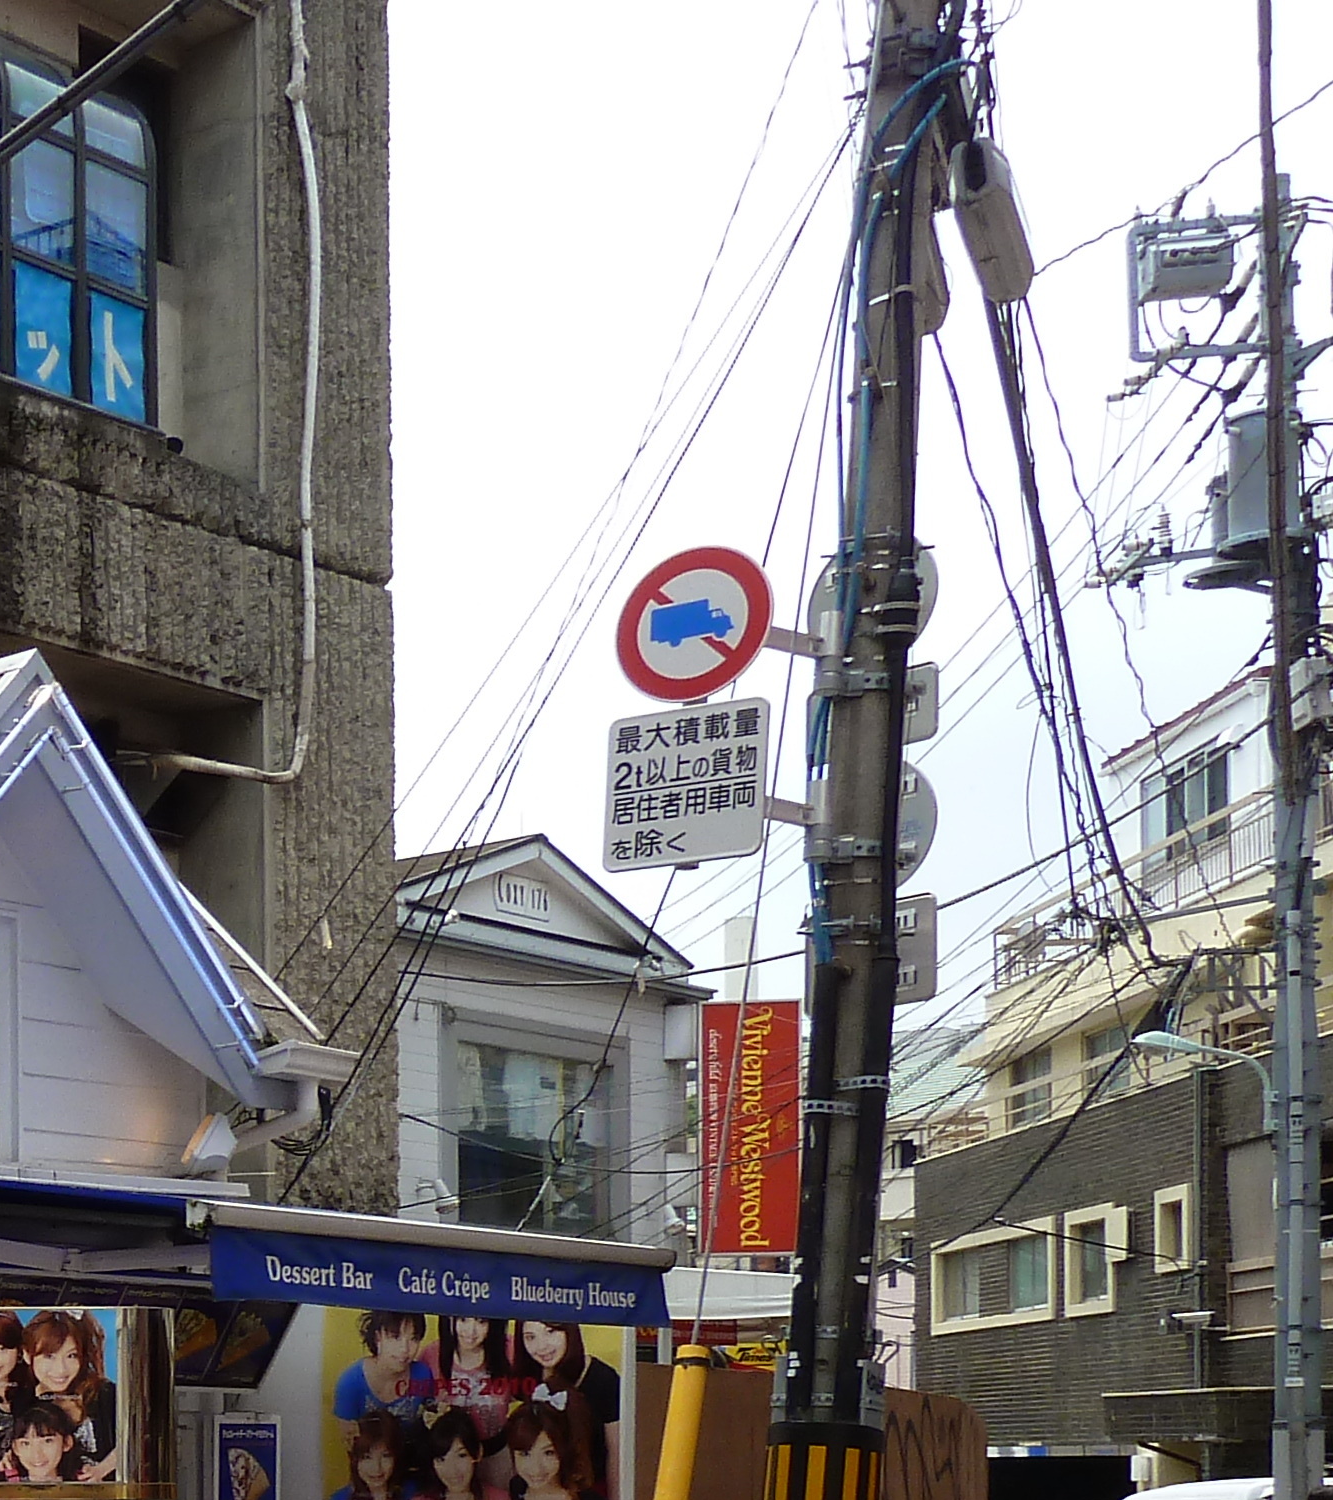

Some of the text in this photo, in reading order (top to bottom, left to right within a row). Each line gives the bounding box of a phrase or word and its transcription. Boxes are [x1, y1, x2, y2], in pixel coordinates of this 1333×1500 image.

[615, 706, 761, 754] 最大積載量
[614, 744, 757, 789] 2t以上の貨物
[612, 783, 756, 825] 居住者用車両
[610, 830, 687, 861] を除く
[739, 1005, 774, 1248] Vivienne Westwood
[264, 1254, 637, 1311] Dessert Bar Café Crêpe Blueberry House
[478, 1376, 536, 1397] 2010
